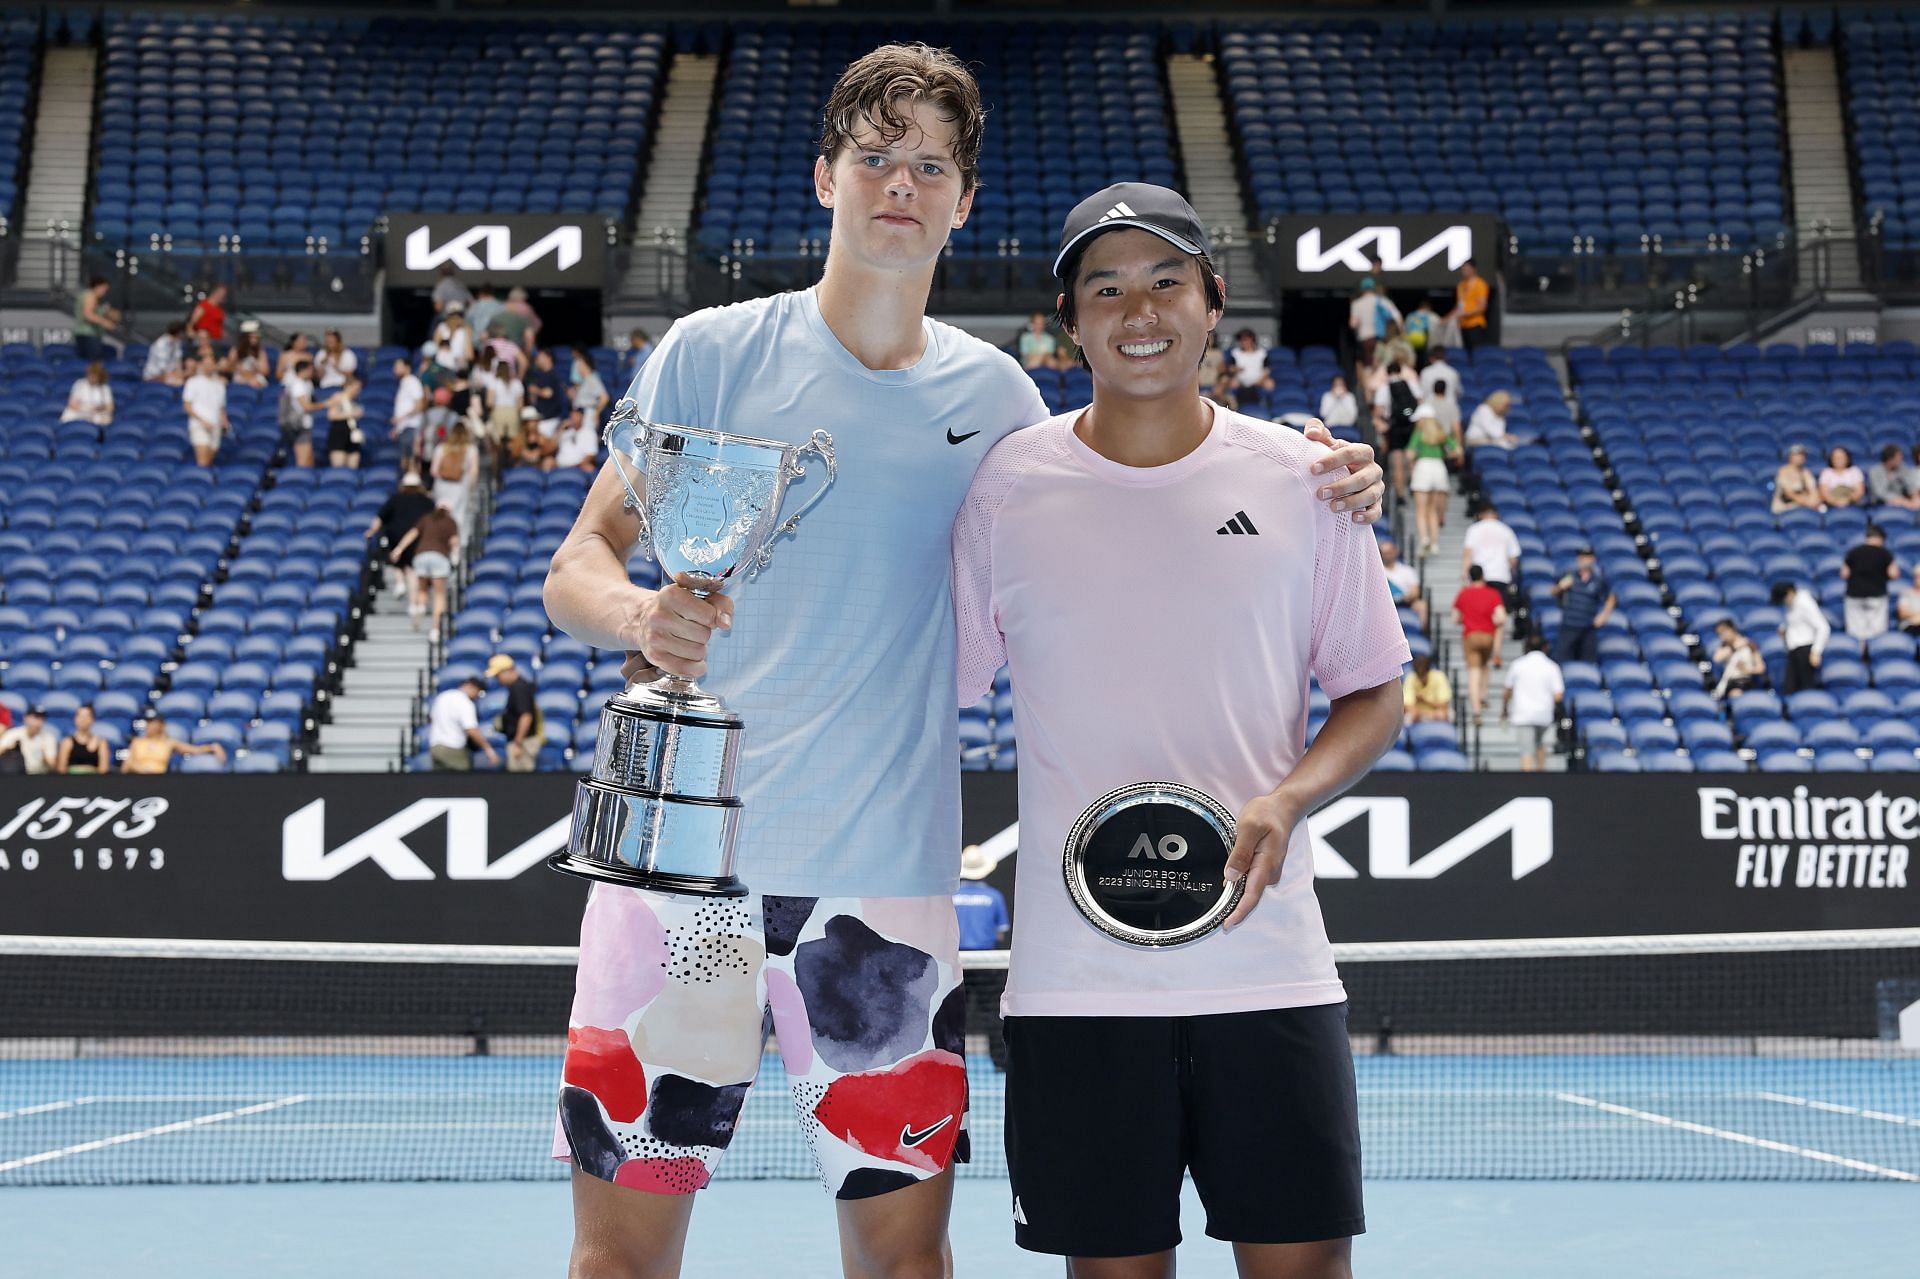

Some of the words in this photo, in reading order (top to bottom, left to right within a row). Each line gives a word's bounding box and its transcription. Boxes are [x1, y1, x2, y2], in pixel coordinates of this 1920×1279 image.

[406, 225, 582, 271] KIA
[1297, 226, 1472, 272] KIA
[0, 796, 169, 840] 1573
[1698, 785, 1920, 840] Emirate
[73, 848, 165, 870] 1573
[1127, 832, 1188, 861] AO
[1735, 844, 1790, 888] FLY
[1795, 844, 1909, 888] BETTER
[1098, 877, 1123, 887] 2023
[1125, 878, 1167, 890] SINGLES
[1169, 880, 1213, 893] FINALIST
[1121, 868, 1159, 880] JUNIOR
